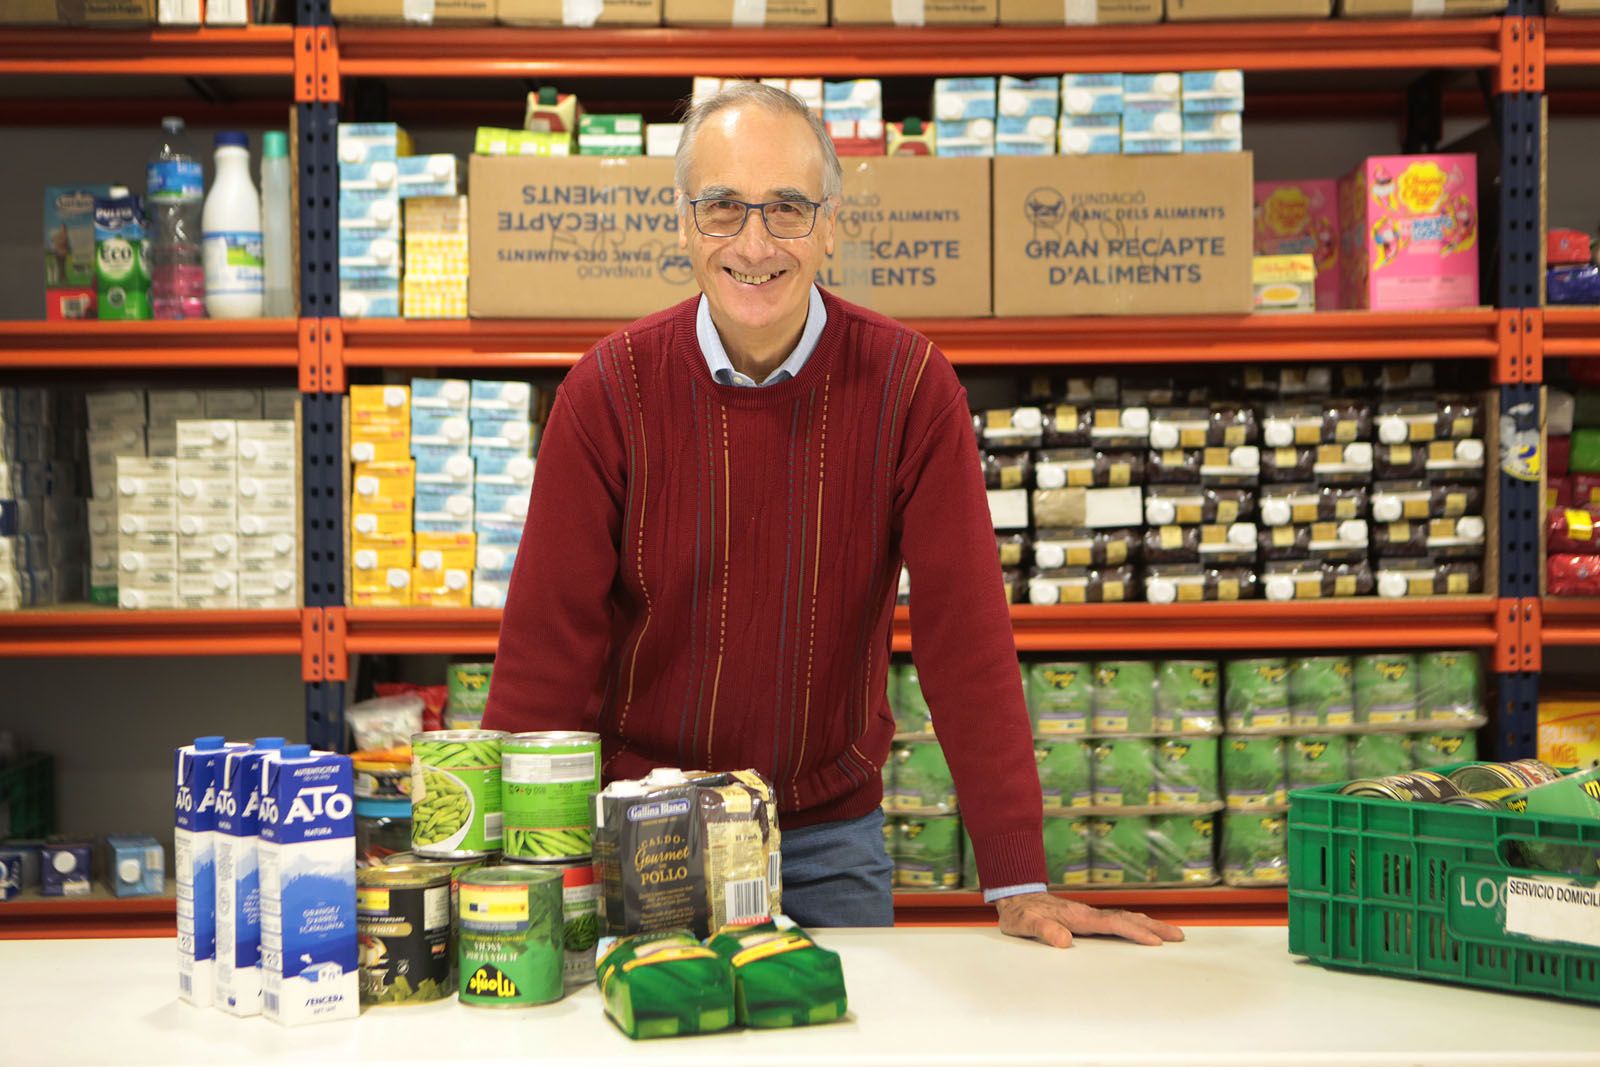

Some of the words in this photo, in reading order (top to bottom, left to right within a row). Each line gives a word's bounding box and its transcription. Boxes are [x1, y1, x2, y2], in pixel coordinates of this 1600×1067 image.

[522, 184, 675, 206] D'ALIMENTS
[1071, 190, 1146, 205] FUNDACIÓ
[498, 212, 616, 232] RECAPTE
[625, 213, 680, 232] RAN
[889, 209, 960, 222] ALIMENTS
[1115, 207, 1149, 220] DELS
[1154, 206, 1225, 220] ALIMENTS
[497, 249, 569, 263] ALIMENTS
[1025, 239, 1099, 259] GRAN
[1107, 236, 1226, 257] RECAPTE
[1049, 263, 1203, 285] D'ALIMENTS
[175, 787, 193, 812] ATO
[214, 790, 236, 817] ATO
[283, 785, 353, 825] ATO
[630, 803, 660, 819] Gallina
[661, 800, 687, 815] Blanca
[258, 797, 279, 824] ATO
[634, 846, 690, 874] Gourmet
[641, 867, 688, 885] POLLO
[1509, 880, 1555, 901] SERVICIO
[469, 969, 516, 997] Monje
